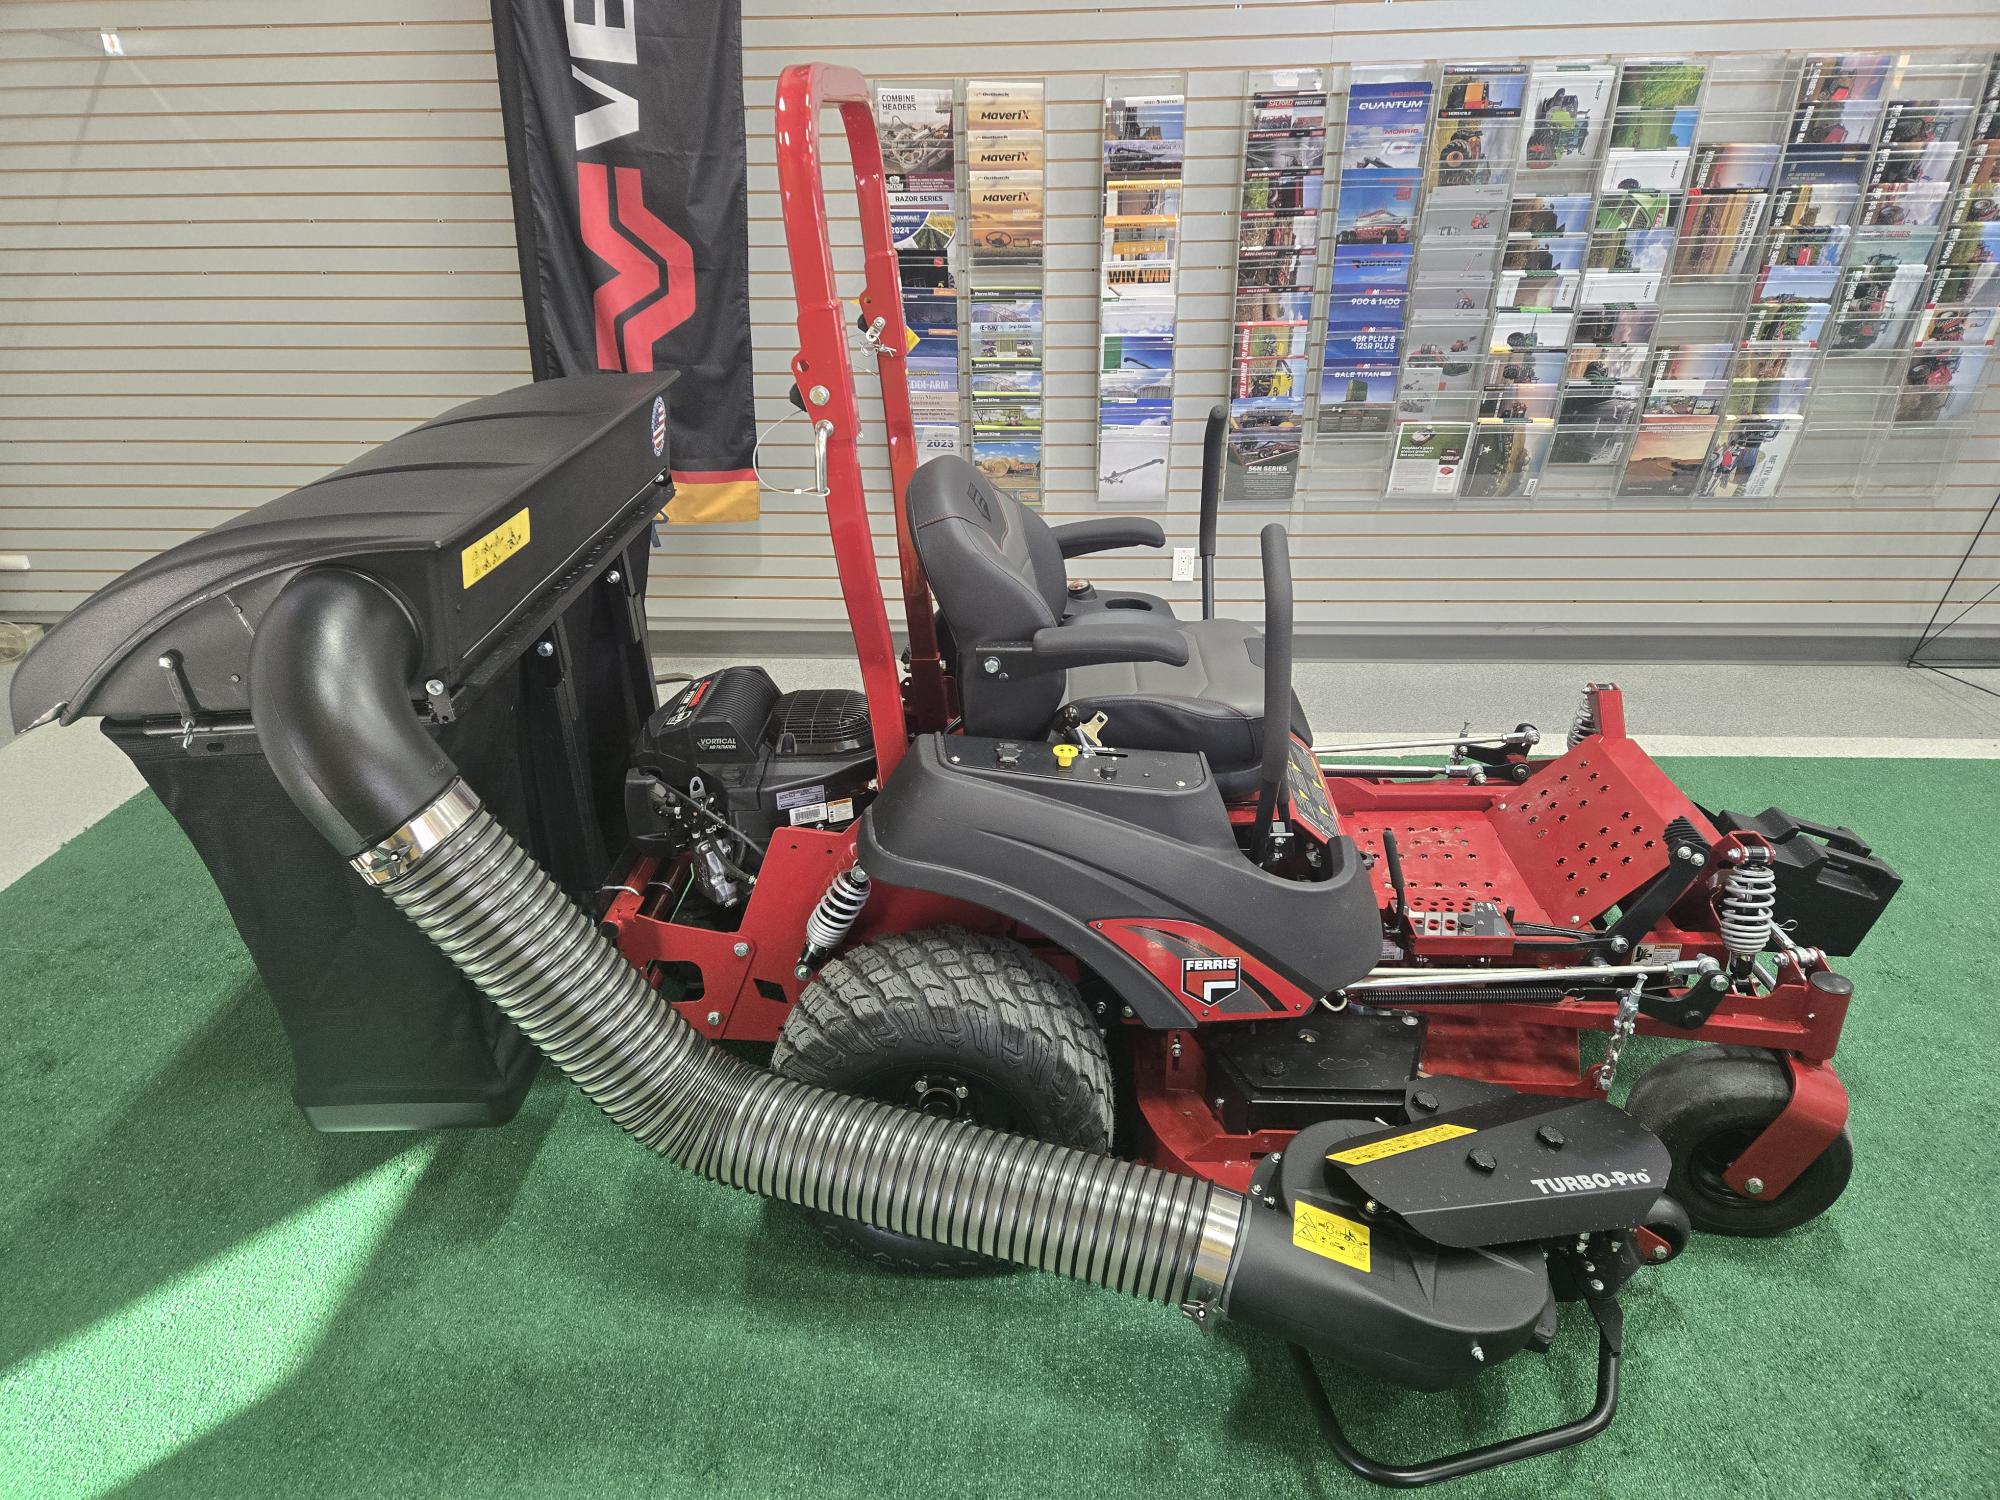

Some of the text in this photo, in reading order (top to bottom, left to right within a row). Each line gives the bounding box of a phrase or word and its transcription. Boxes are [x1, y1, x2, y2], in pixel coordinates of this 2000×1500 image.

[881, 94, 916, 103] COMBINE
[882, 103, 917, 111] HEADERS
[1359, 100, 1424, 110] QUANTUM
[981, 109, 1031, 120] MaveriX
[980, 151, 1029, 162] MaveriX
[982, 192, 1031, 202] MaveriX
[1109, 270, 1136, 284] WIN
[1378, 297, 1400, 305] 1400
[926, 439, 954, 448] 2023
[1186, 959, 1237, 971] FERRIS
